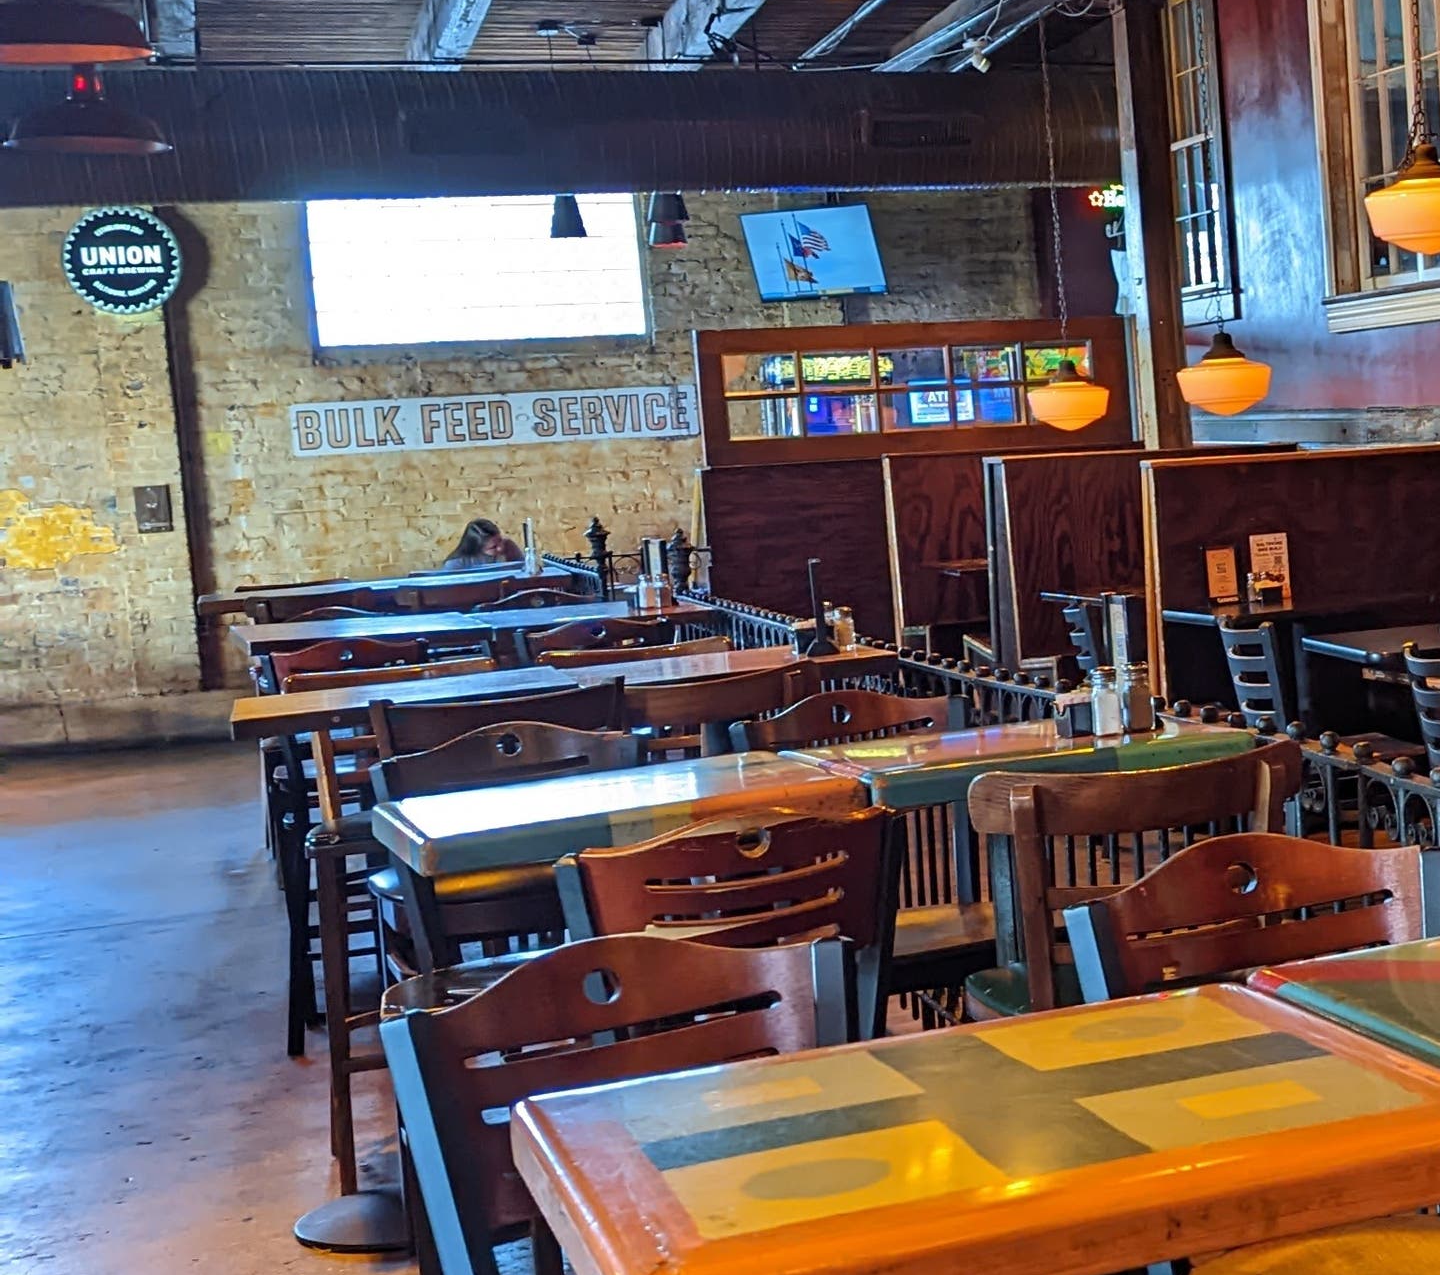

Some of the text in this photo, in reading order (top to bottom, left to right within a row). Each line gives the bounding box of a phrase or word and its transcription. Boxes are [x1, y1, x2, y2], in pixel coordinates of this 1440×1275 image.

[80, 245, 162, 265] UNION
[295, 391, 690, 450] BULK FEED SERVICE
